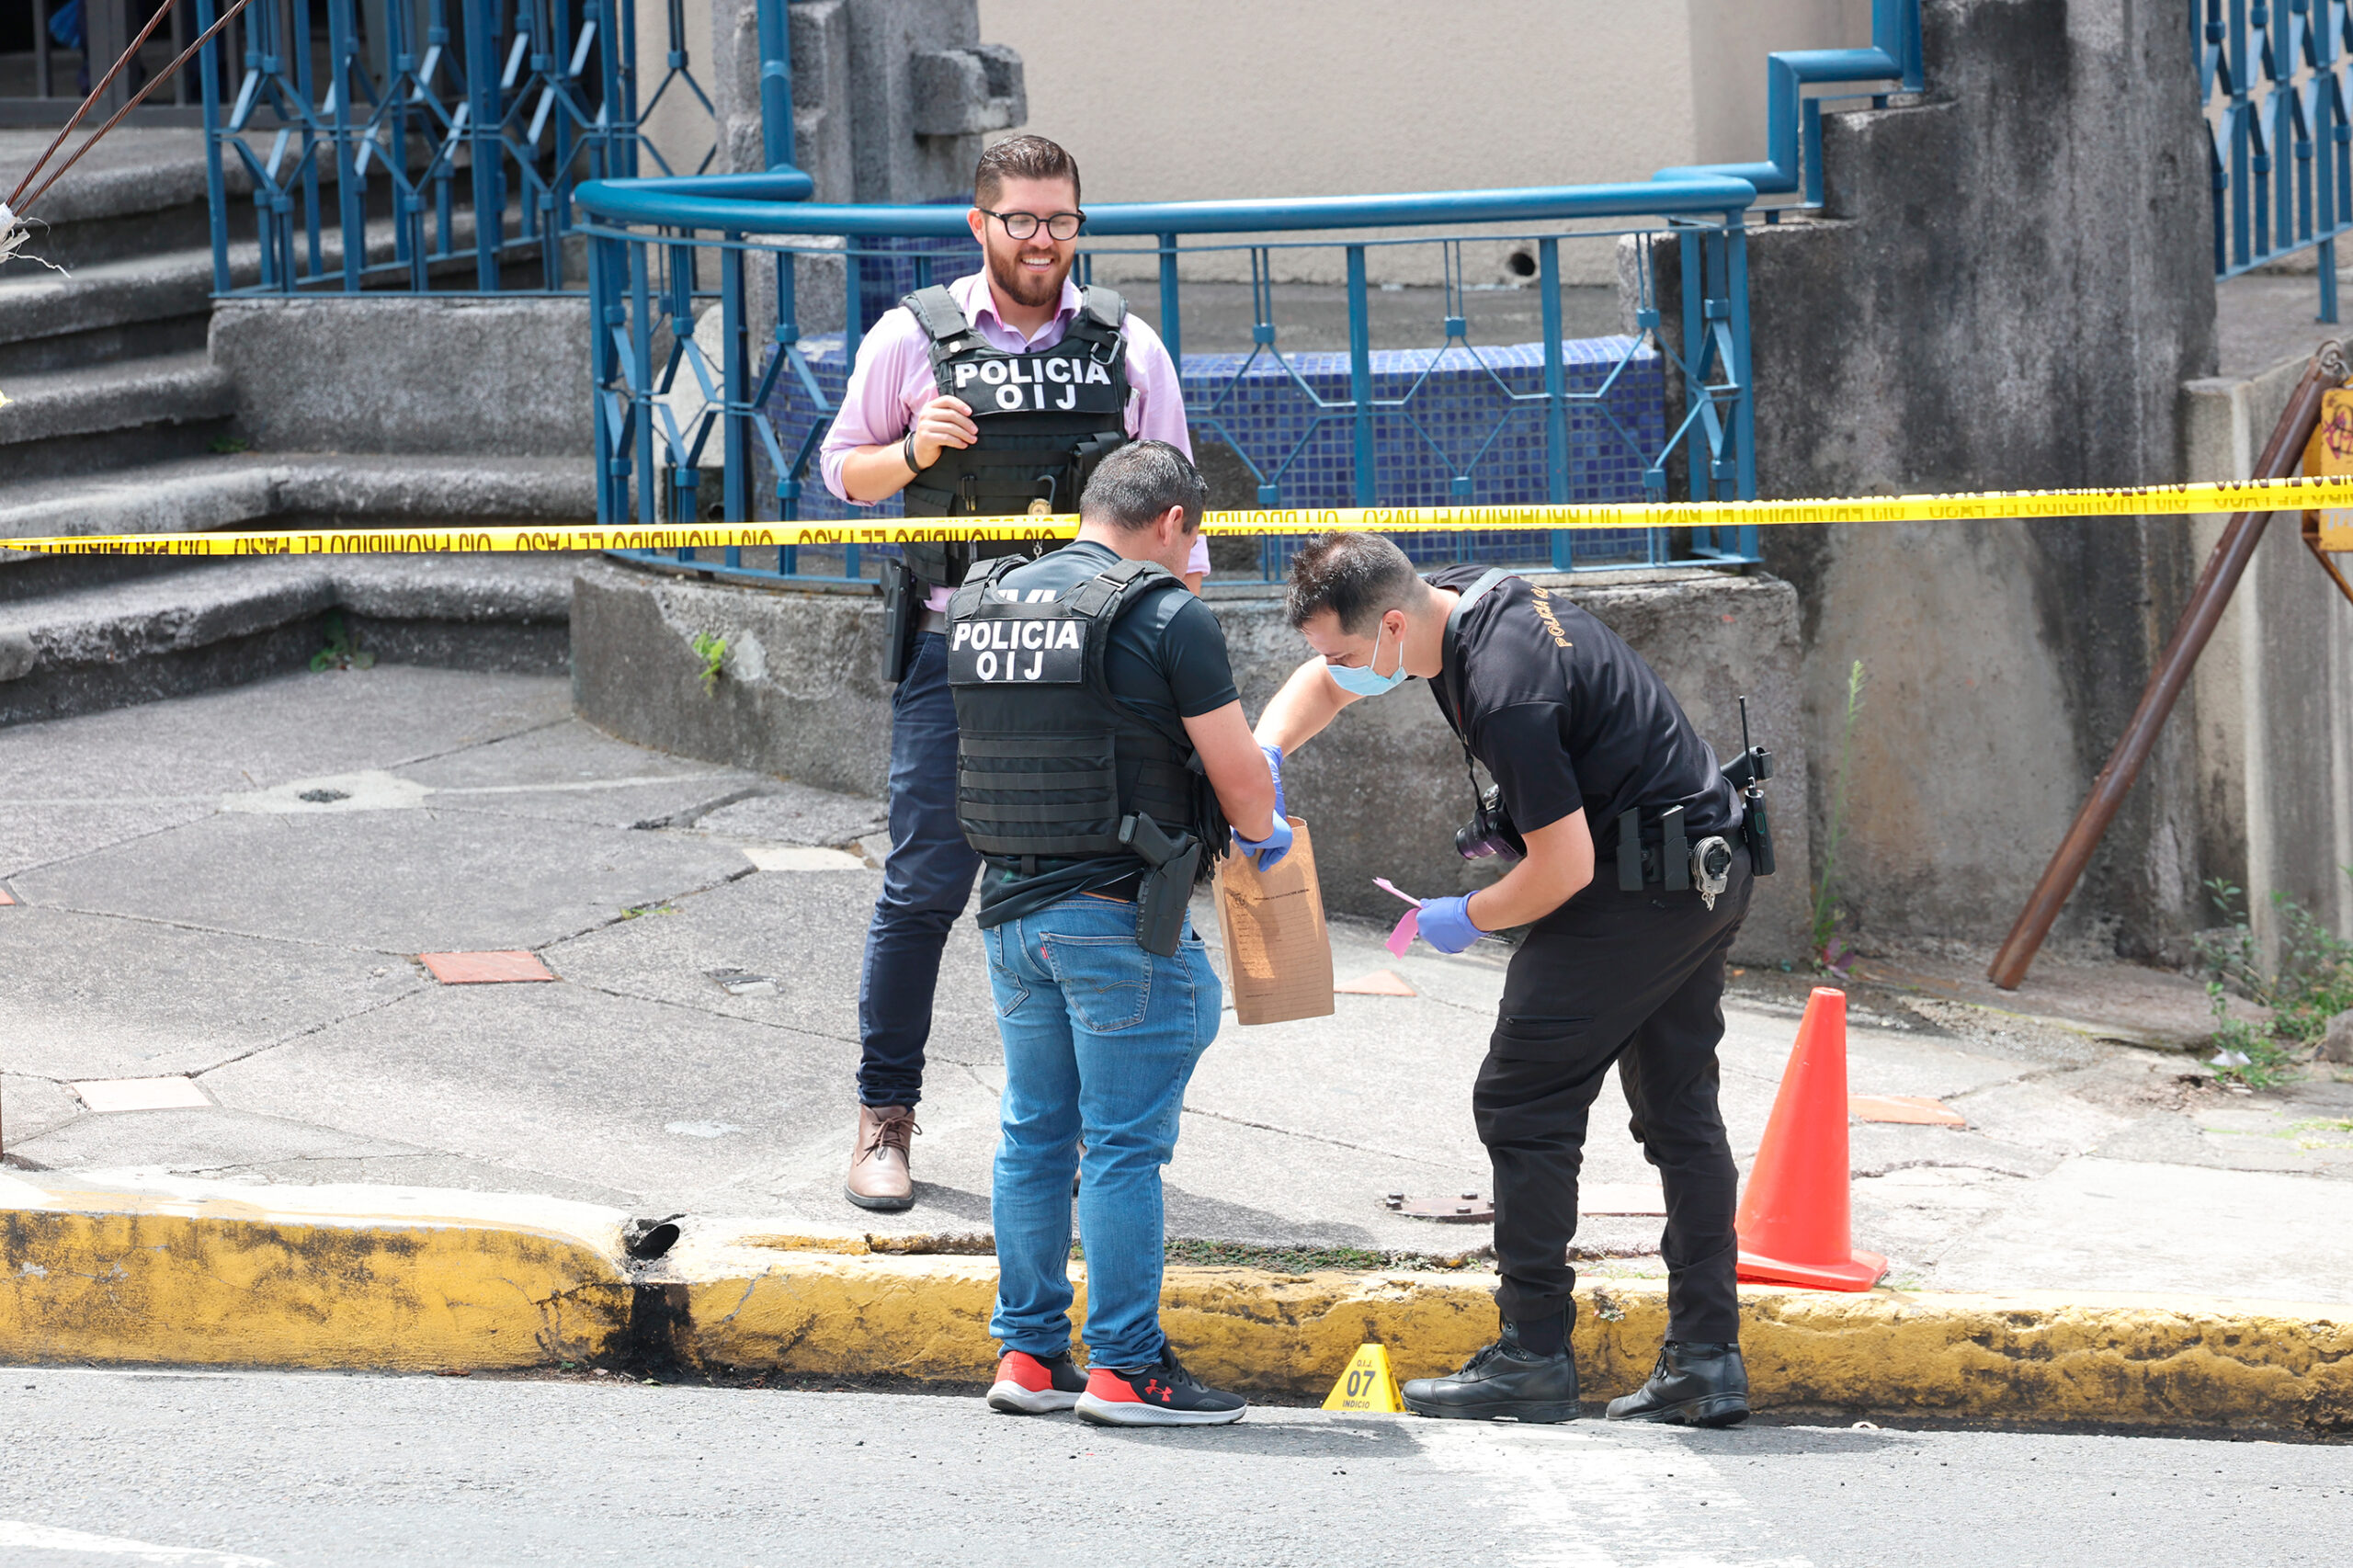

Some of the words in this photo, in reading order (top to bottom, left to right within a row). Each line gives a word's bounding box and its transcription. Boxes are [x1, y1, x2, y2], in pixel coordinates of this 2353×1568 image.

[955, 358, 1111, 389] POLICIA
[995, 384, 1077, 410] OIJ
[952, 620, 1080, 651] POLICIA
[1531, 599, 1574, 647] POLICIA
[976, 651, 1044, 680] OIJ
[1347, 1370, 1376, 1397] 07
[1342, 1400, 1370, 1409] INDICIO
